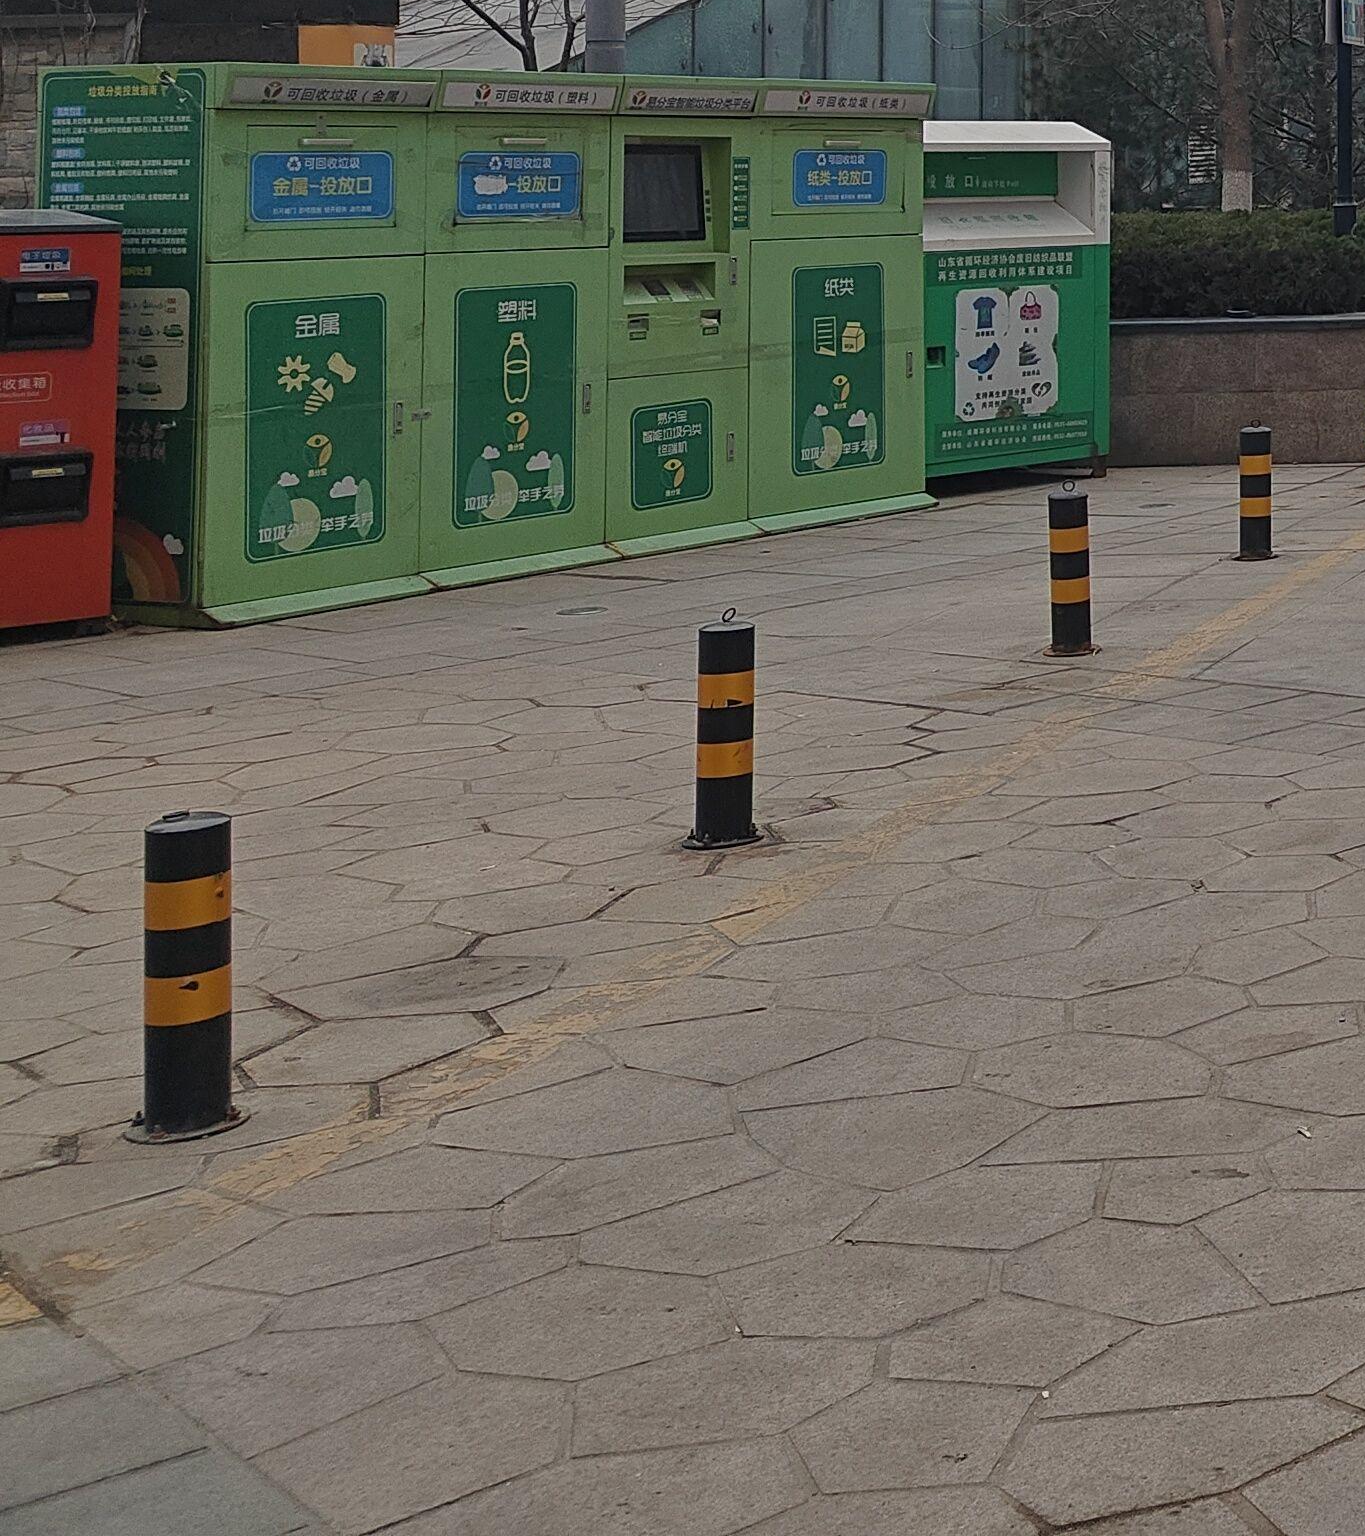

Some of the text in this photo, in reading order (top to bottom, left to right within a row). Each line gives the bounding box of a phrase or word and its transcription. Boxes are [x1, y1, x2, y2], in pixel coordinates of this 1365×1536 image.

[495, 88, 598, 105] 可回收垃圾（塑料）
[816, 96, 907, 110] 可回收垃圾（纸类）
[304, 157, 360, 169] 可回收垃圾
[504, 157, 552, 169] 可回收垃圾
[828, 154, 866, 164] 可回收垃圾
[824, 277, 855, 298] 纸类
[497, 299, 537, 323] 塑料
[294, 312, 340, 339] 金属
[0, 376, 47, 390] 收集箱
[657, 410, 688, 425] 易分宝
[642, 423, 702, 444] 智能垃圾分类
